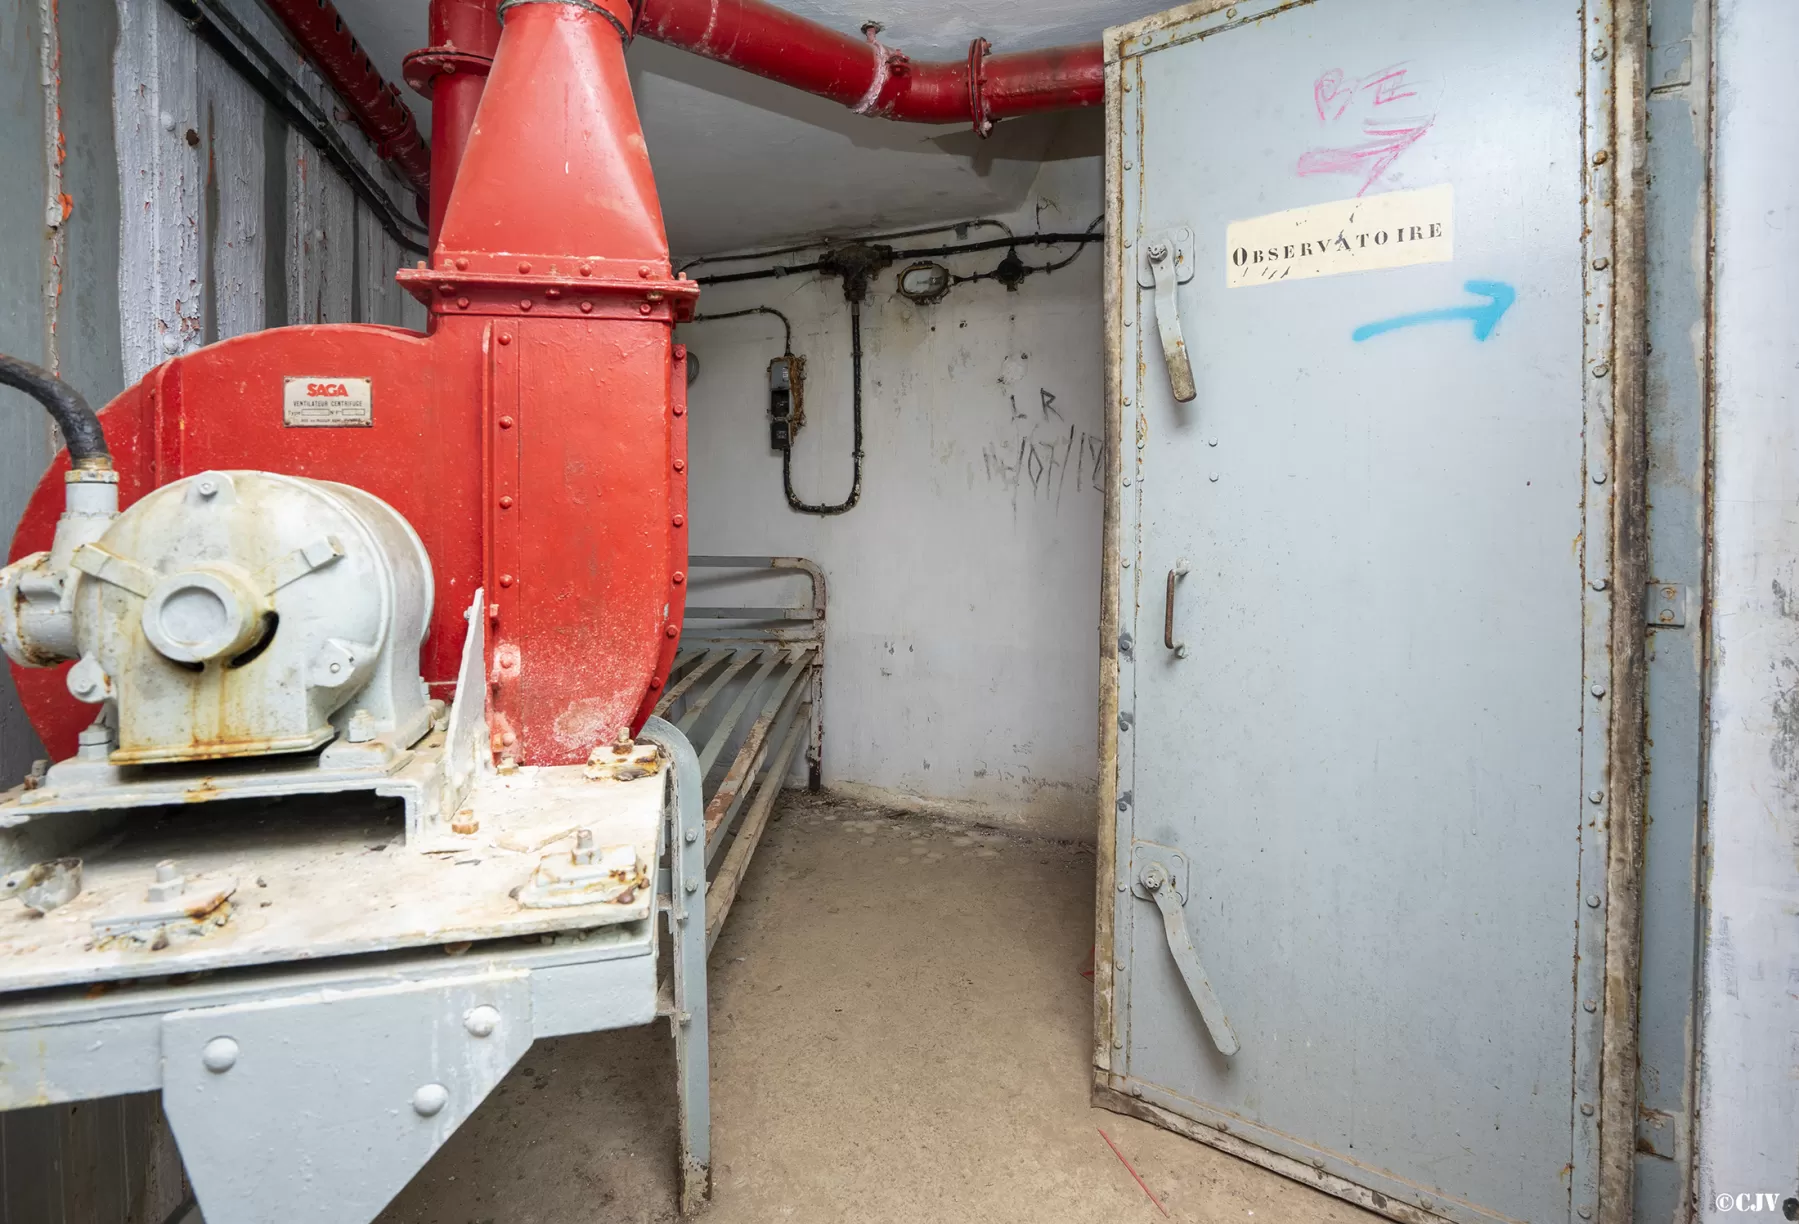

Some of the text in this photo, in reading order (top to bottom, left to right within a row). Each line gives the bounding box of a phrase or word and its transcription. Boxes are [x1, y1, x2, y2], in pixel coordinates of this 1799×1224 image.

[1232, 222, 1443, 267] OBSERVATOIRE
[307, 383, 349, 397] SAGA
[293, 400, 363, 408] VENTILATEUR CENTRIFUGE
